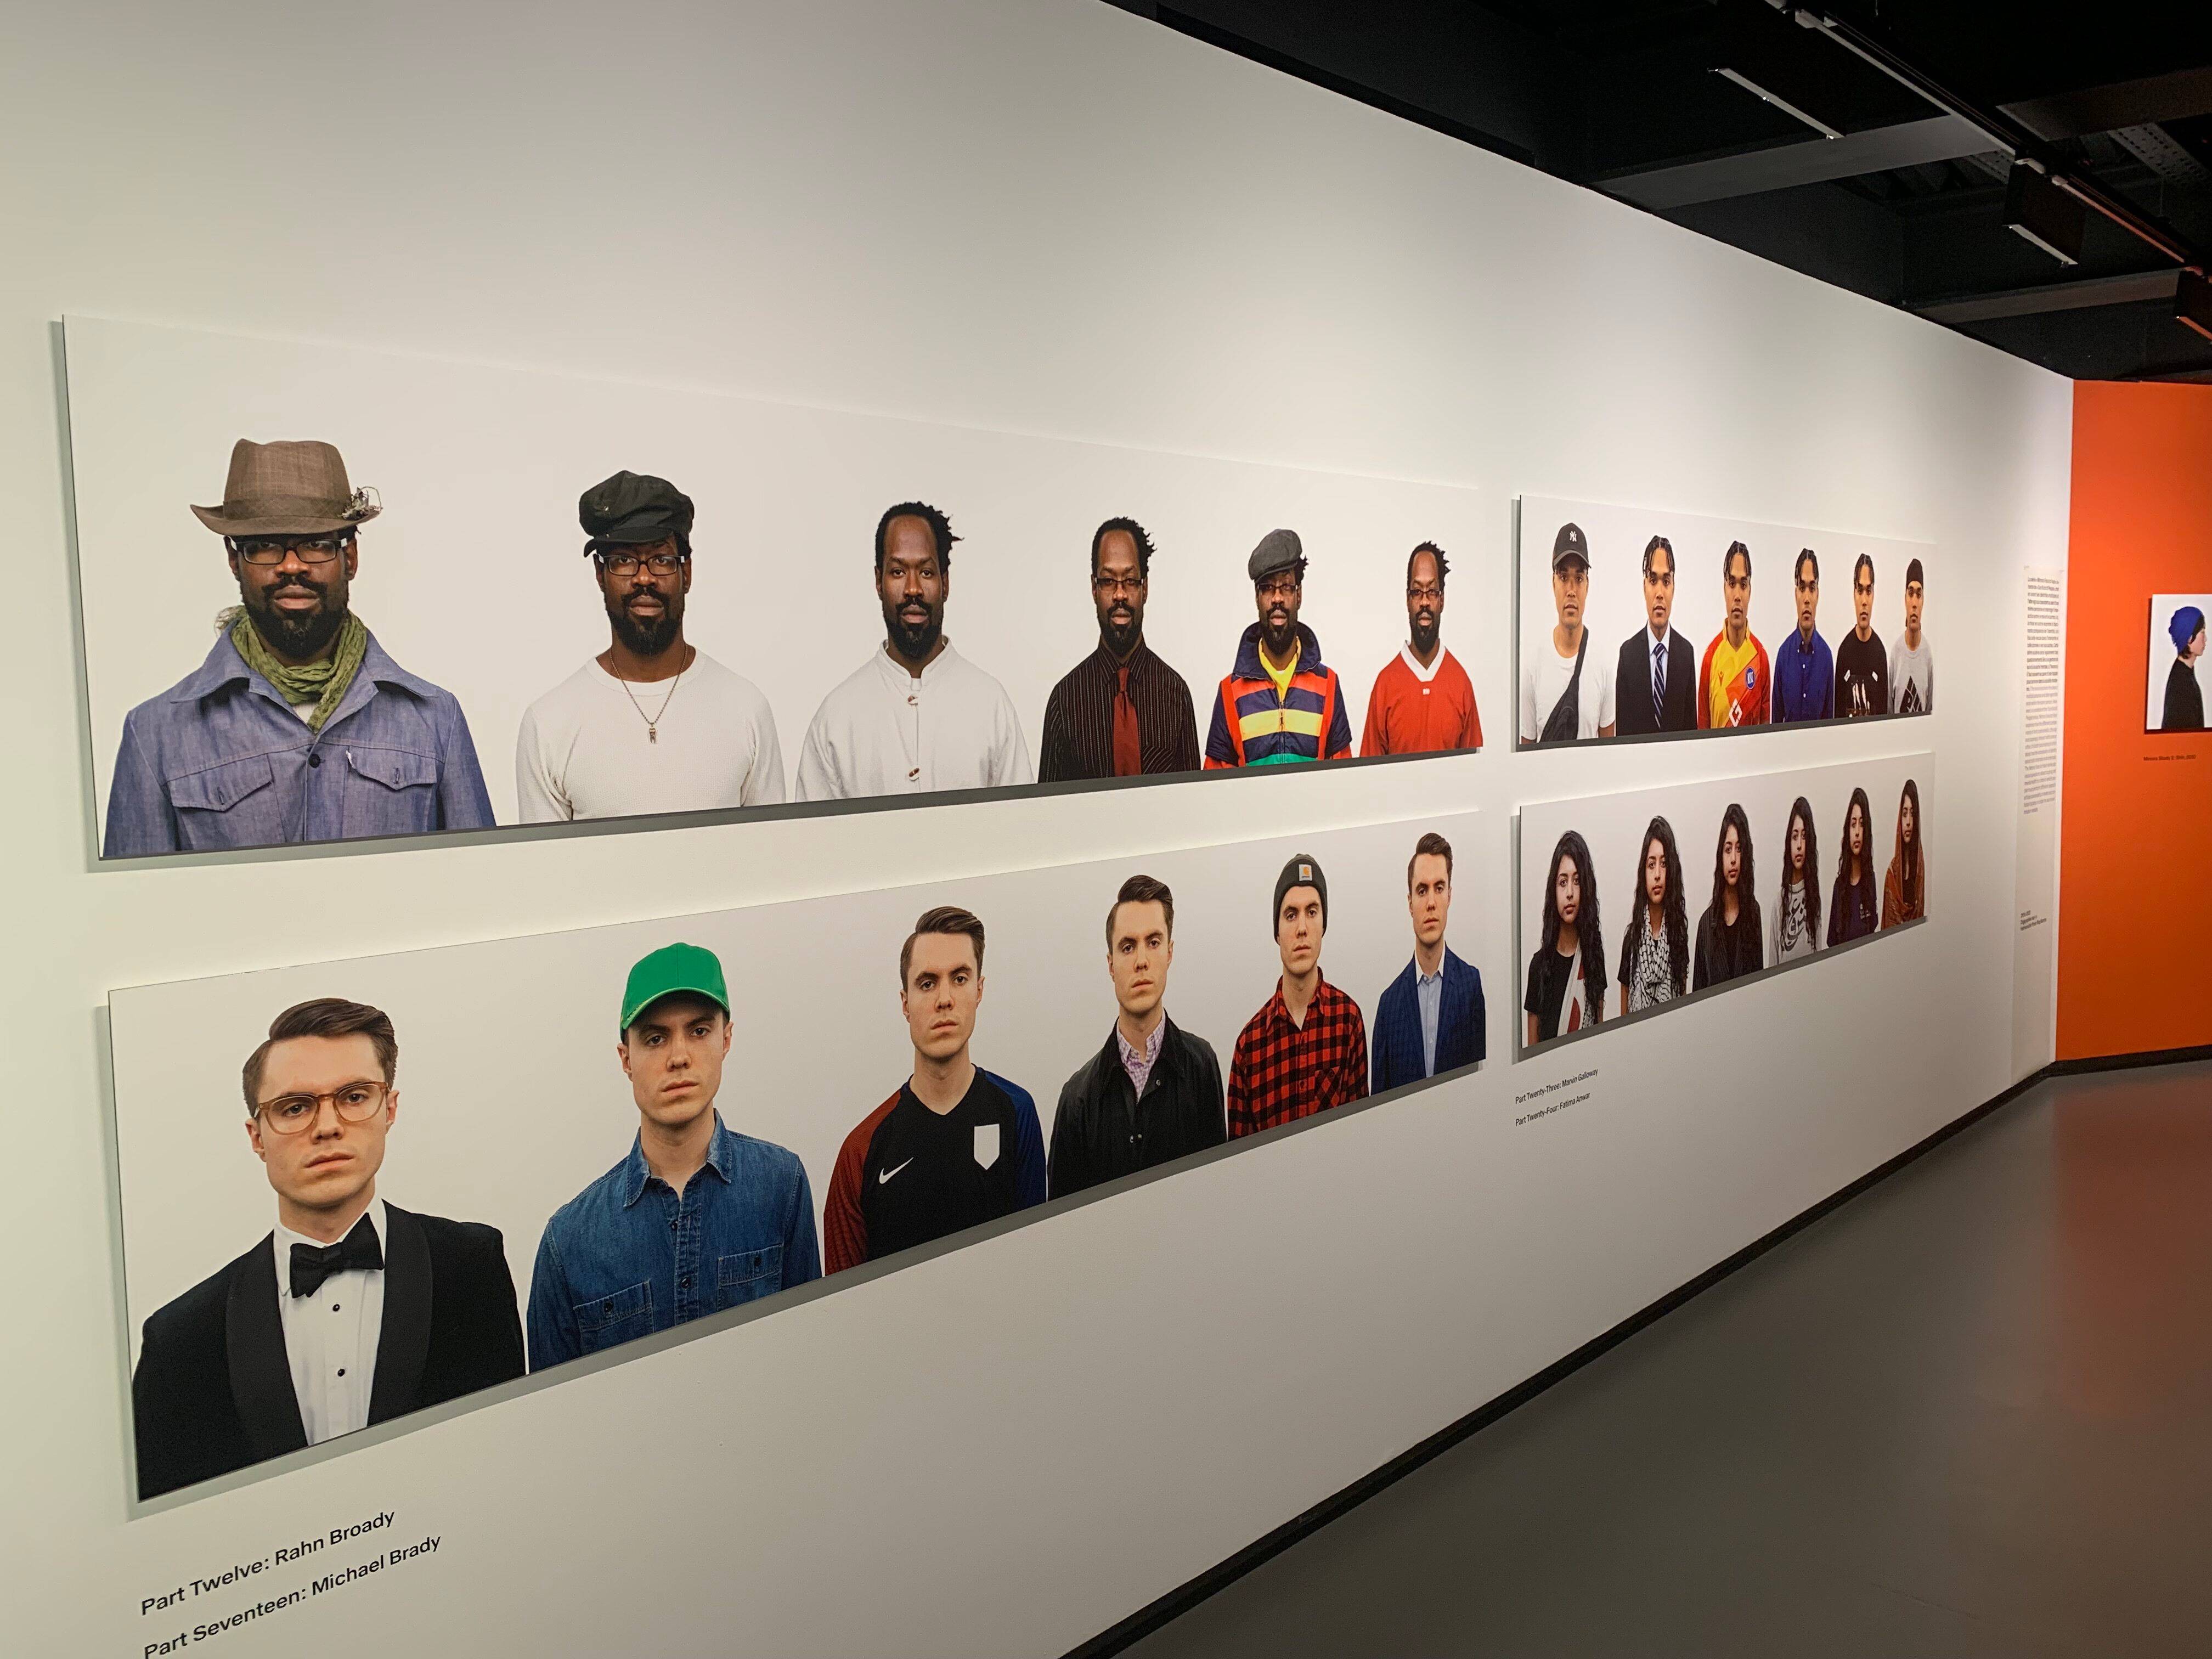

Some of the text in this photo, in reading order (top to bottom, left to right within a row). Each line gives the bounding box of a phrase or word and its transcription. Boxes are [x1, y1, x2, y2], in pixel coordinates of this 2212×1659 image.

[1515, 1069, 1599, 1104] Part Twenty-Three: Marvin Galloway
[1515, 1092, 1590, 1126] Part Twenty-Four: Fatima Anwar
[142, 1511, 395, 1616] Part Twelve: Rahn Broady
[144, 1536, 442, 1659] Part Seventeen: Michael Brady
